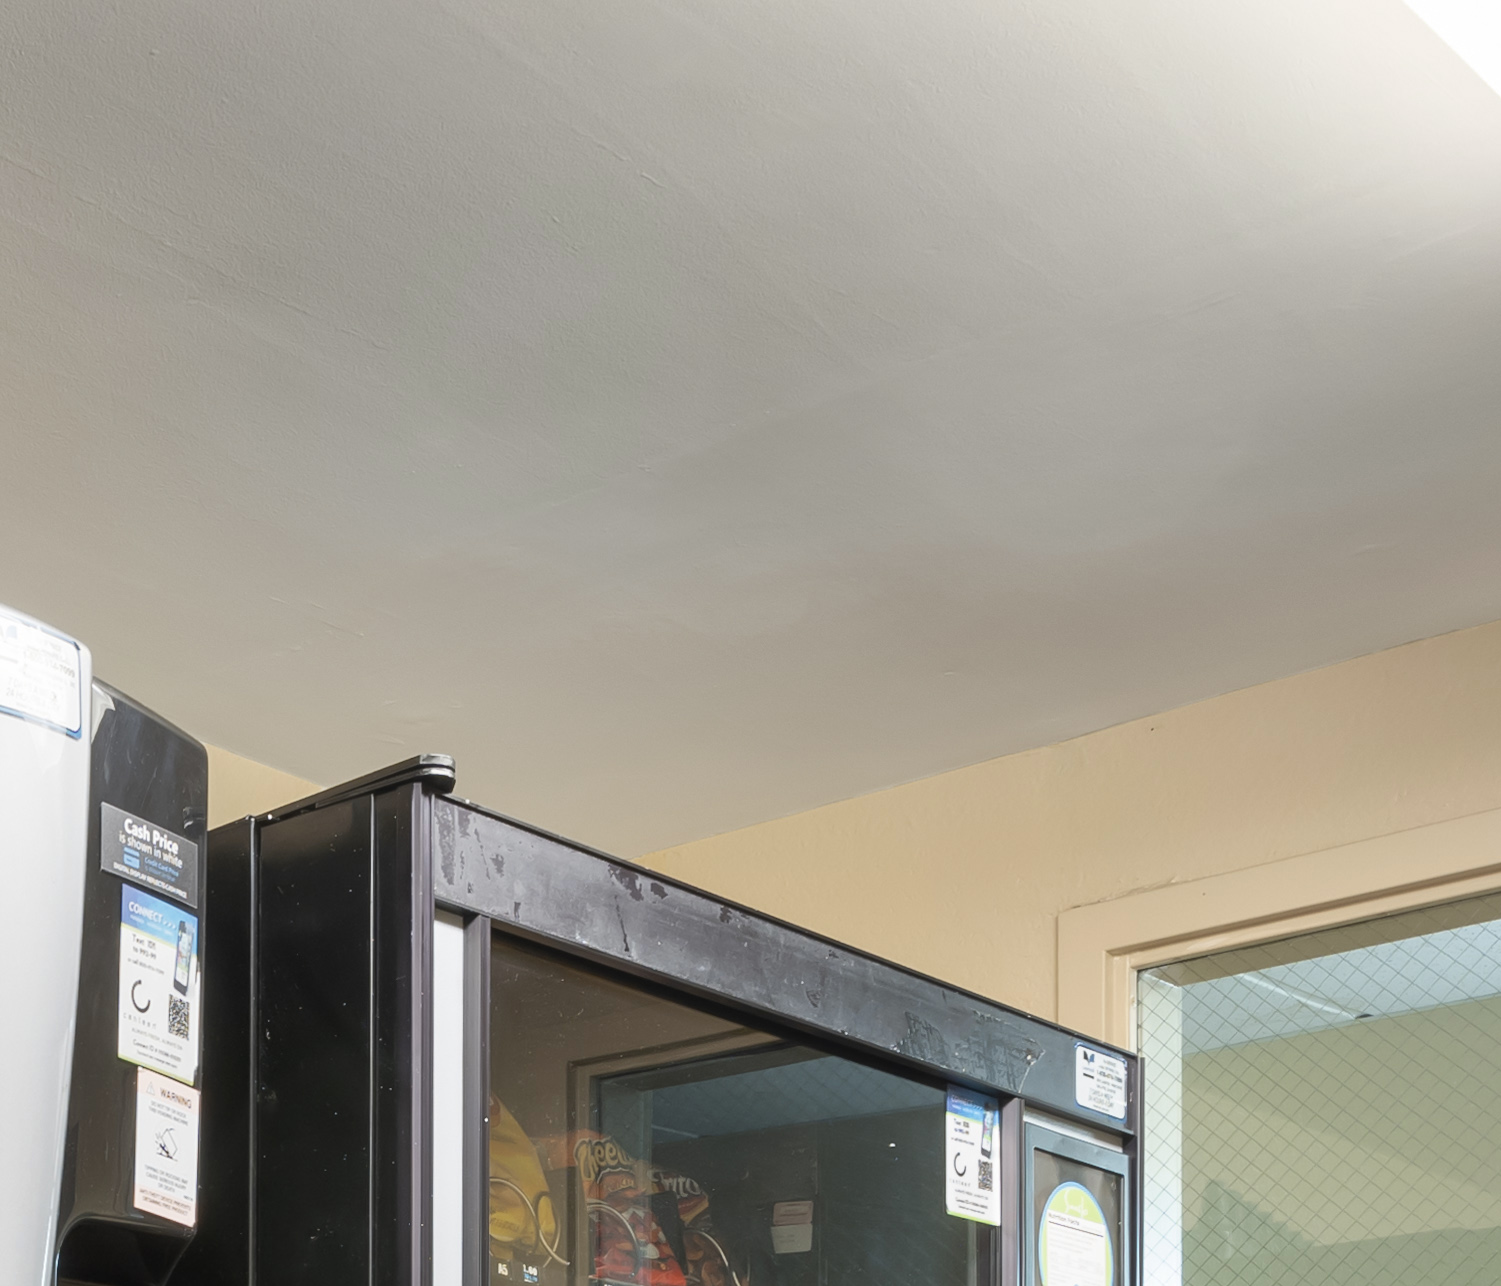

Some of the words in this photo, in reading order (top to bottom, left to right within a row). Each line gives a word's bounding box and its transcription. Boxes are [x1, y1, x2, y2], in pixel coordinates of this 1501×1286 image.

[118, 830, 125, 843] is
[126, 835, 152, 855] shown
[153, 845, 161, 858] in
[162, 850, 183, 868] white
[123, 816, 150, 841] Cash
[152, 829, 179, 854] Price
[128, 901, 164, 924] CONNECT
[159, 1087, 192, 1108] WARNING
